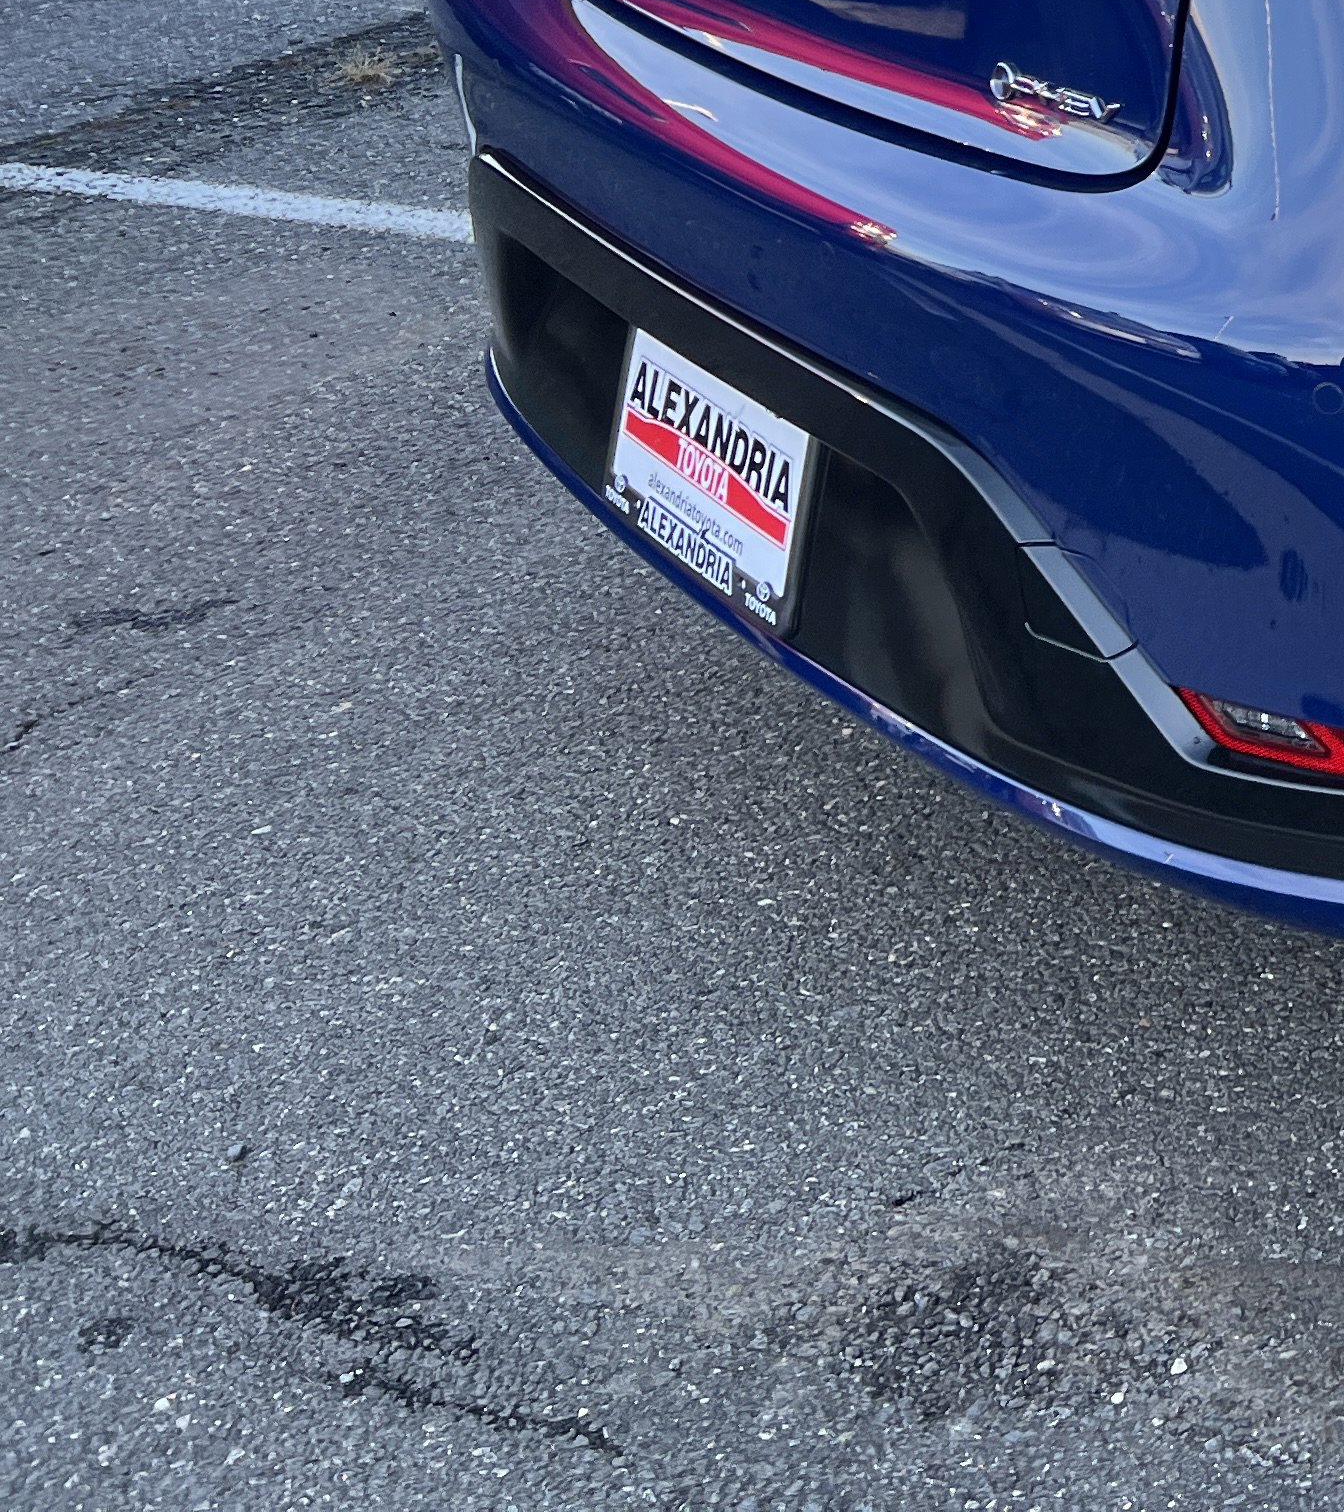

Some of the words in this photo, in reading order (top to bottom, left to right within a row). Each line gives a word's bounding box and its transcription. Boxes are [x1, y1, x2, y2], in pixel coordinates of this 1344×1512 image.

[630, 361, 790, 514] ALEXANDRIA
[675, 437, 730, 505] TOYOTA
[605, 484, 630, 516] TOYOTA
[648, 471, 744, 556] alexandriatoyota.com
[639, 498, 733, 595] ALEXANDRIA
[744, 591, 777, 626] TOYOTA
